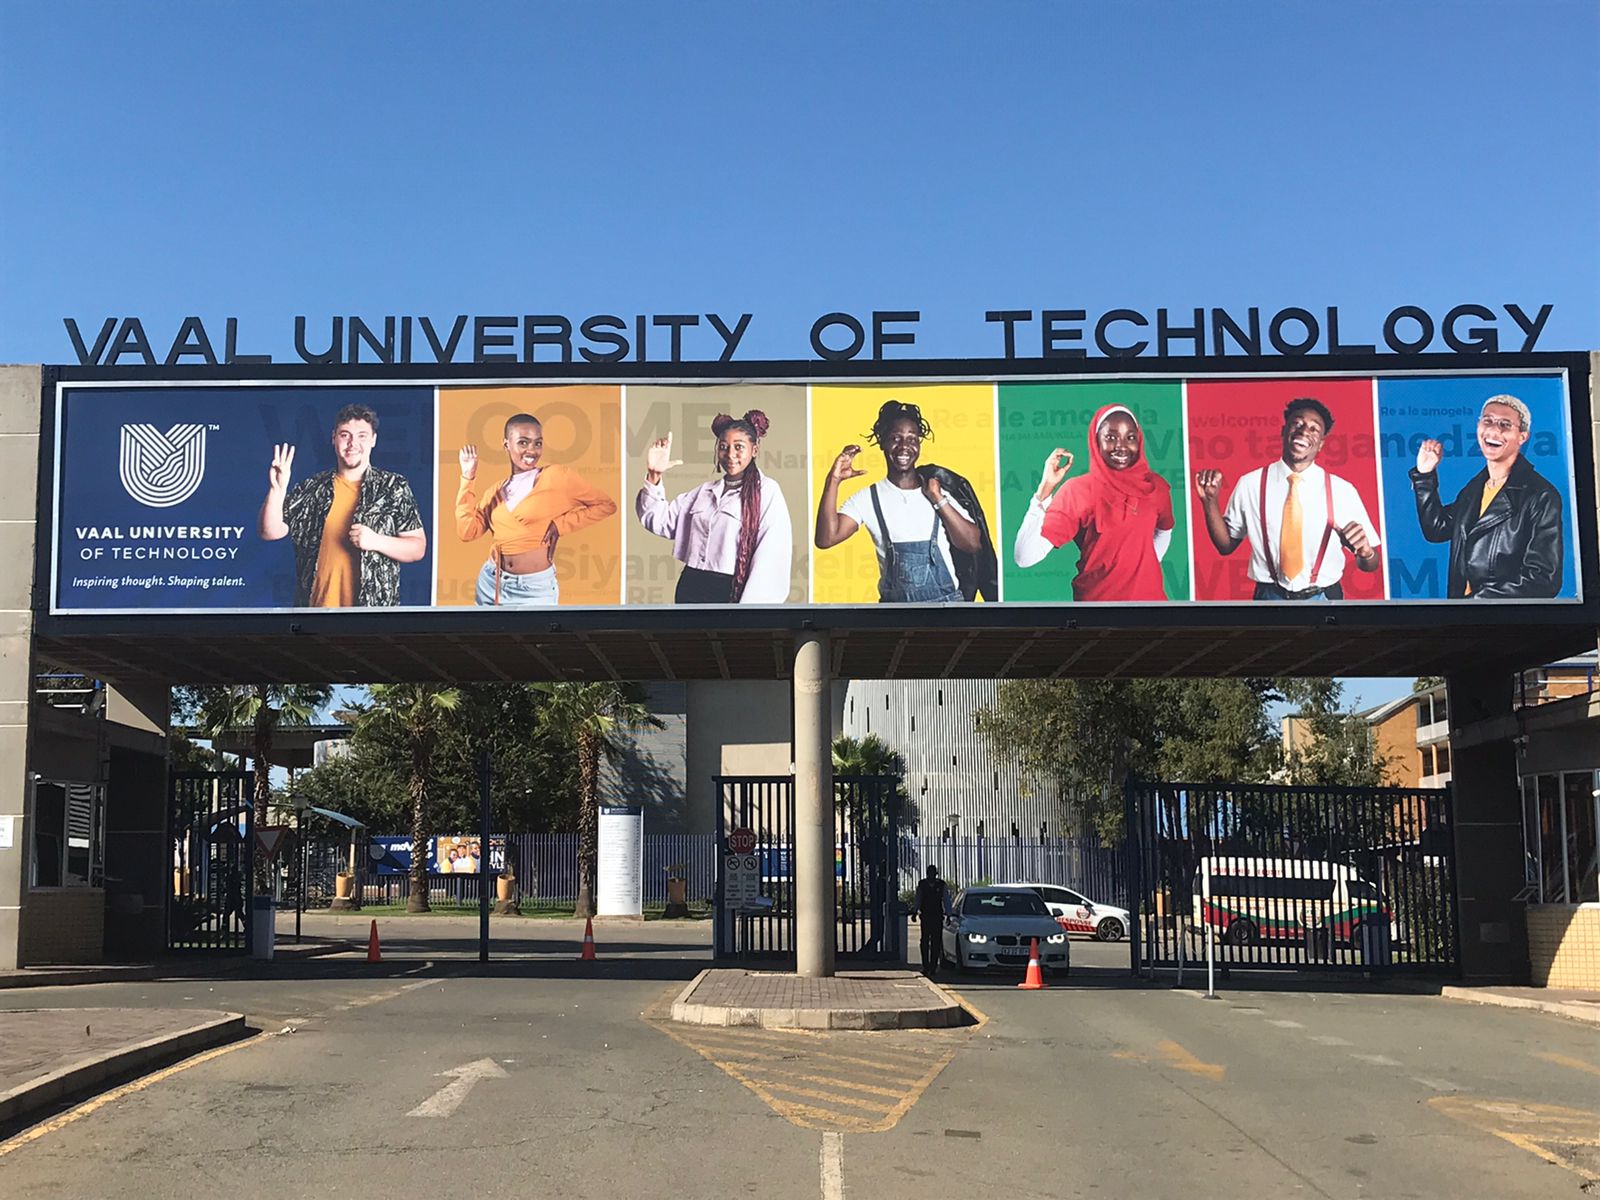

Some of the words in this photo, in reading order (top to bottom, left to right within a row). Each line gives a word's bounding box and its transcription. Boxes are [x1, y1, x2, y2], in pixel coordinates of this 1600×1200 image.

[63, 316, 273, 366] VAAL
[294, 313, 752, 365] UNIVERSITY
[810, 311, 920, 362] OF
[985, 303, 1553, 359] TECHNOLOGY
[1032, 402, 1157, 428] amola
[76, 526, 125, 539] VAAL
[130, 526, 245, 539] UNIVERSITY
[80, 547, 104, 560] OF
[112, 546, 239, 560] TECHNOLOGY
[72, 576, 119, 589] Inspiring
[121, 575, 165, 588] thought.
[168, 575, 209, 589] Shaping
[212, 576, 246, 587] talent.
[731, 835, 754, 847] STOP
